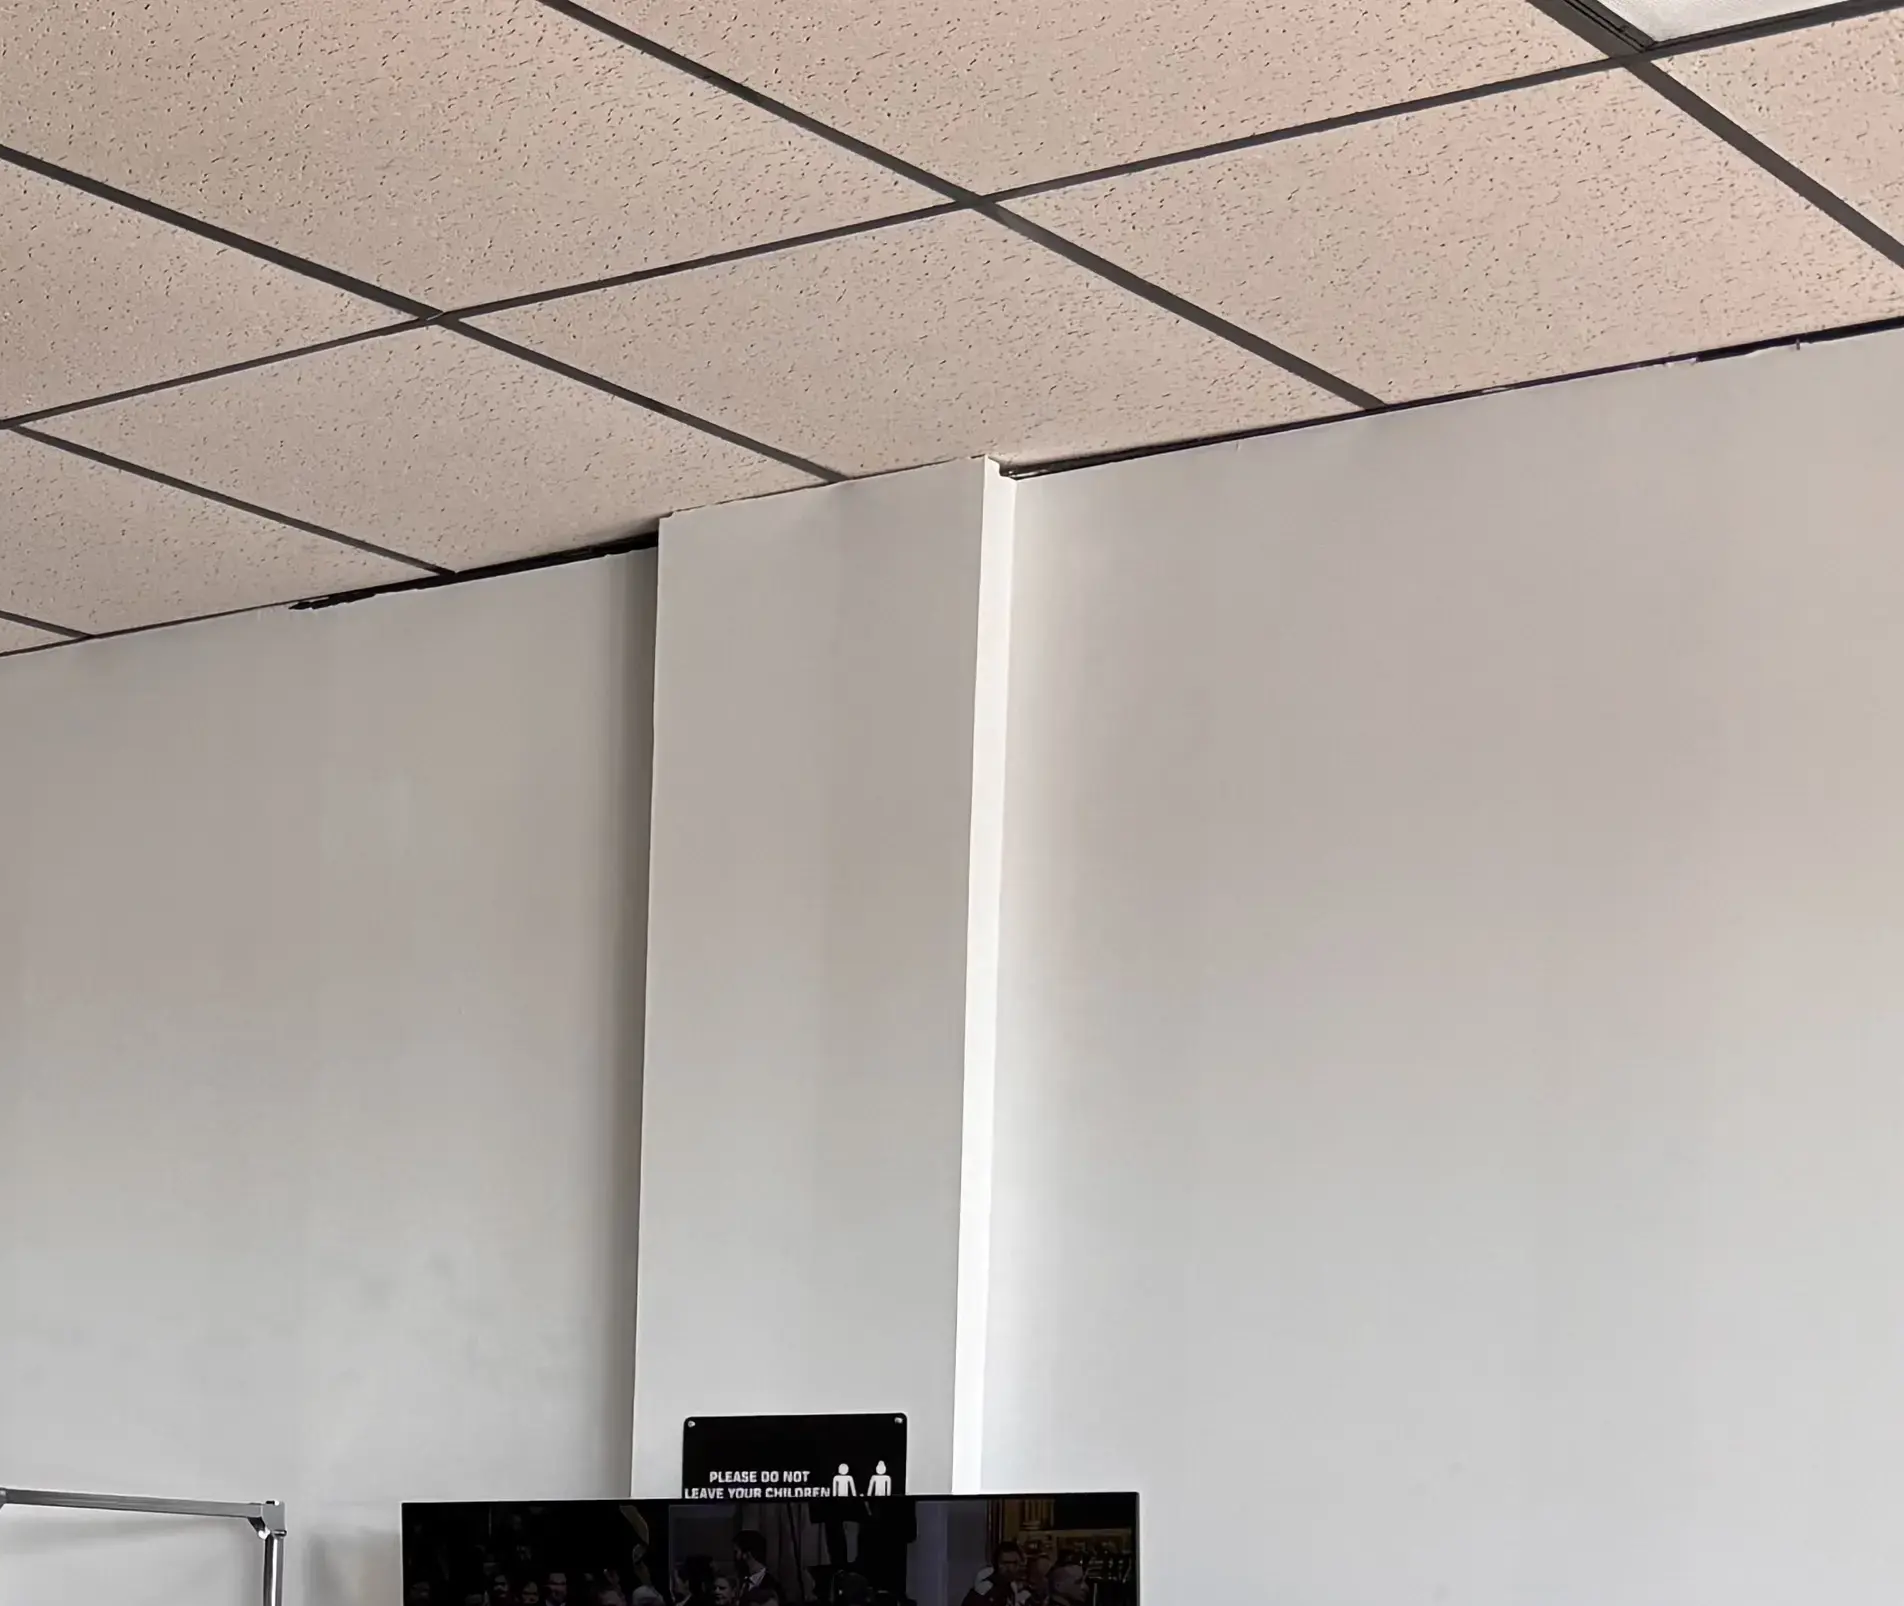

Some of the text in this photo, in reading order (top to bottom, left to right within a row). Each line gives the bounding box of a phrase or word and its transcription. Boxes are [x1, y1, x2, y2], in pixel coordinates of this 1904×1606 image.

[709, 1471, 810, 1483] PLEASE DO NOT
[684, 1487, 831, 1499] LEAVE YOUR CHILDREN
